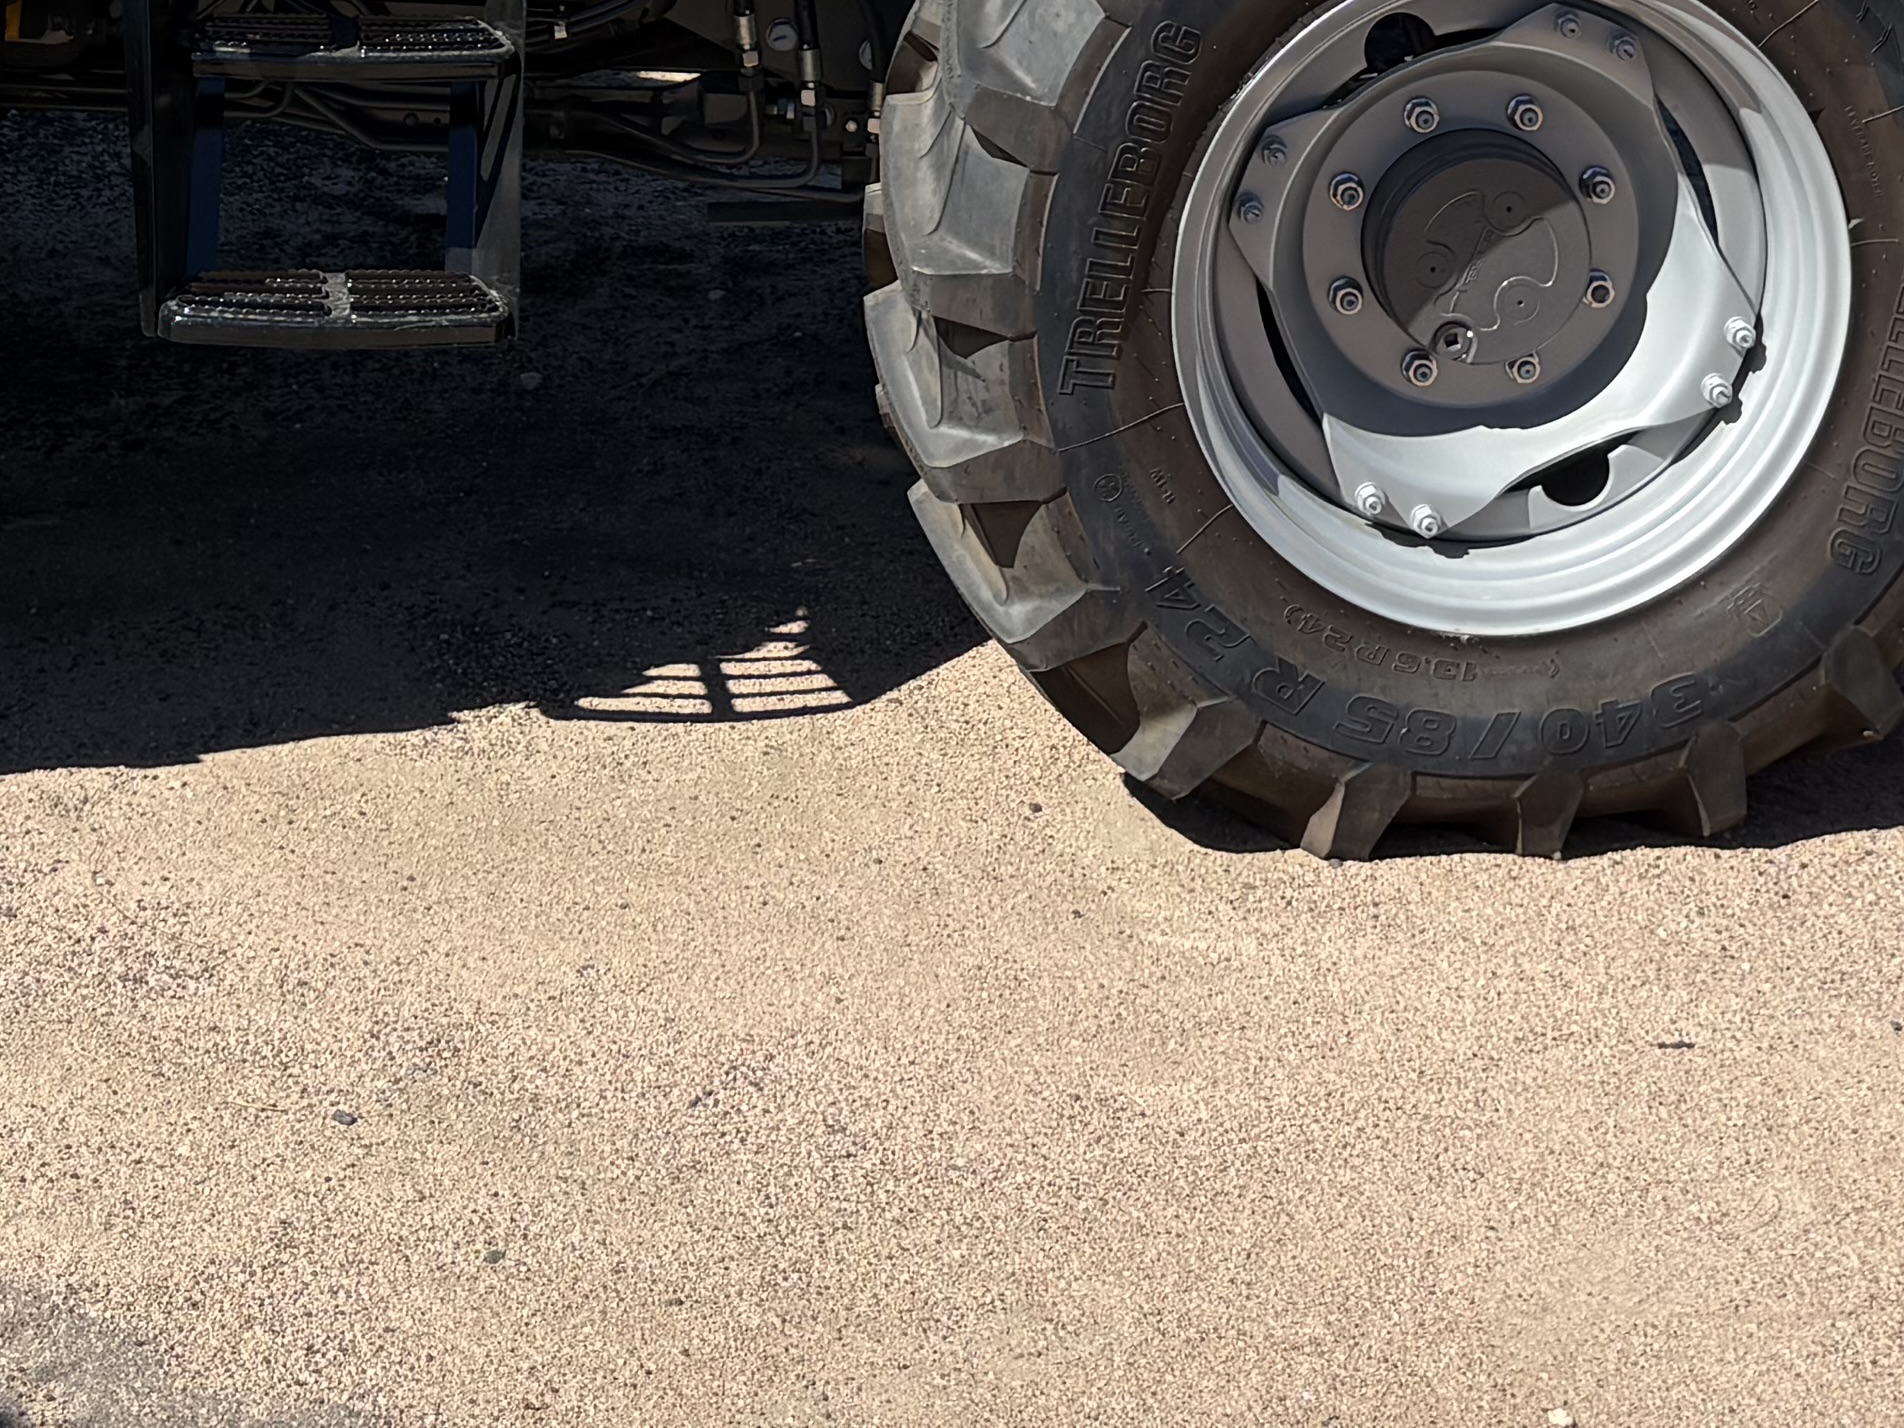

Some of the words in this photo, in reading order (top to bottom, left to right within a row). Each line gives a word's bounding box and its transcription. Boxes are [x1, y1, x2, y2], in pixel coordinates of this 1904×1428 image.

[1059, 18, 1203, 396] TRELLEBORG
[1143, 564, 1251, 662] 24
[1334, 671, 1704, 762] 340/85
